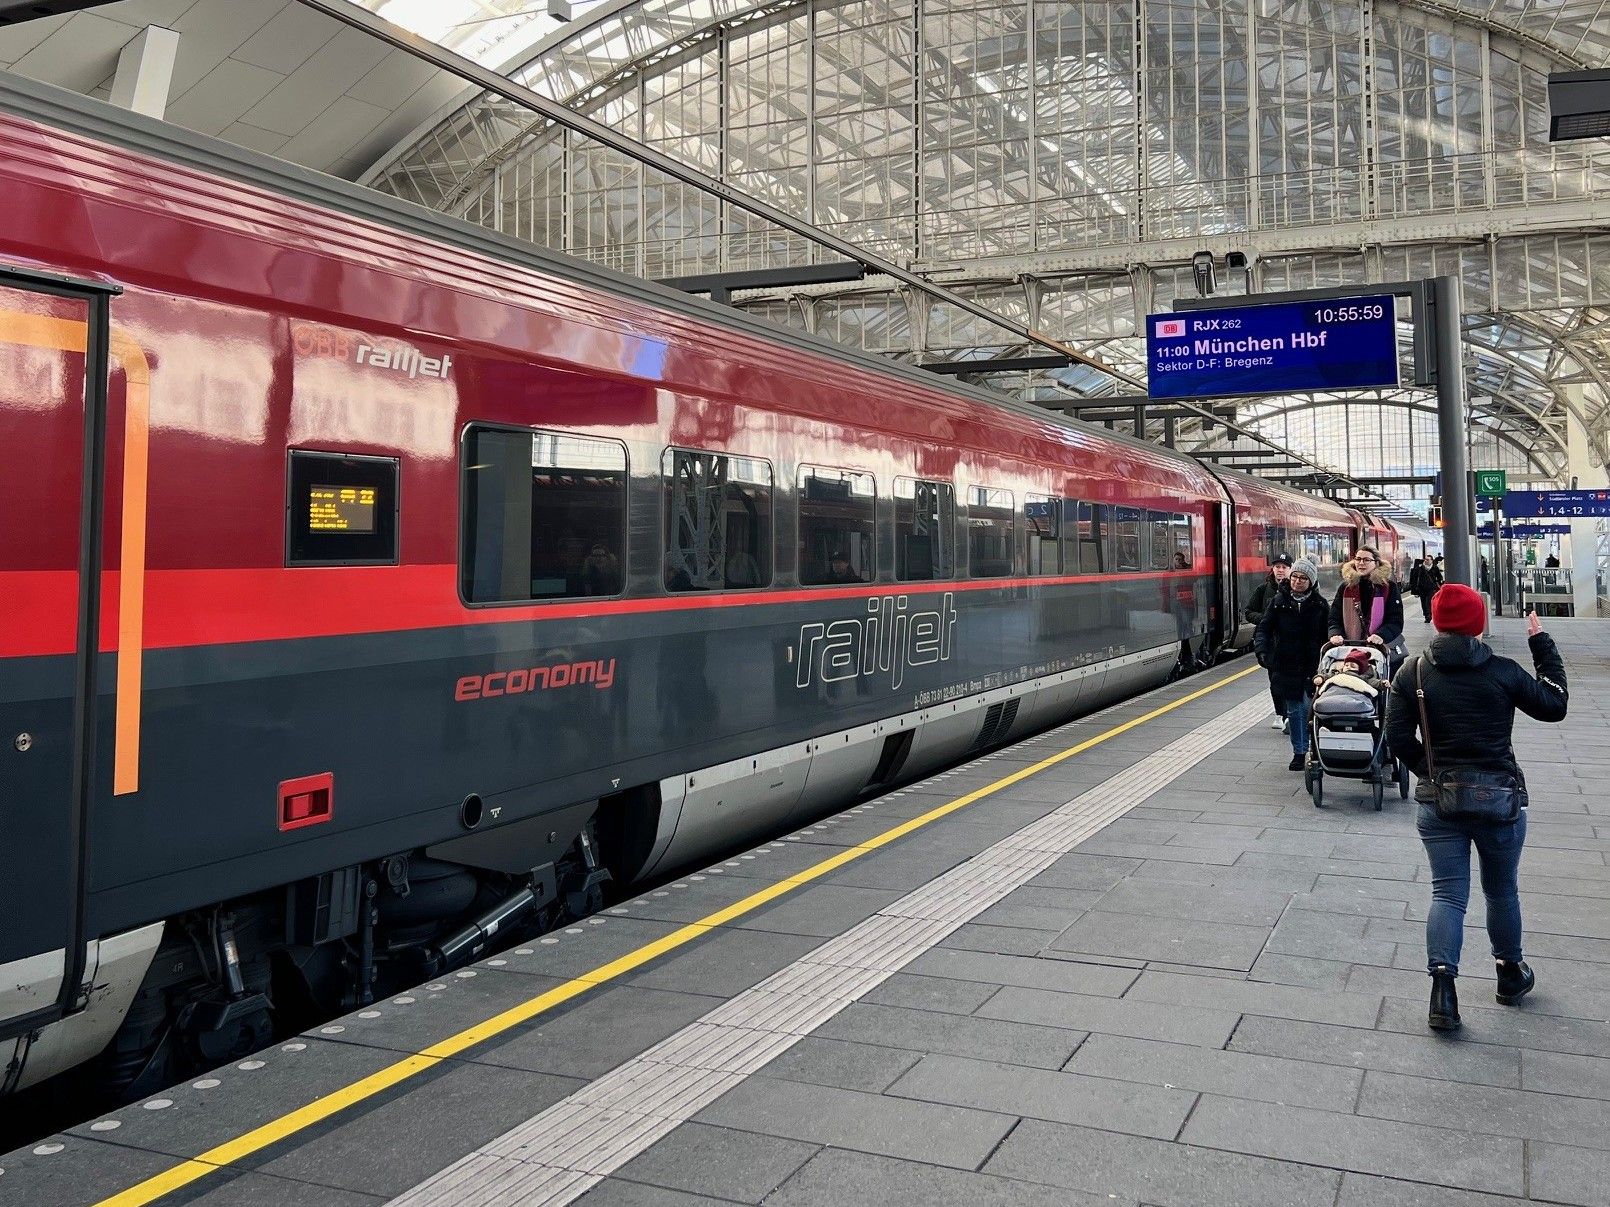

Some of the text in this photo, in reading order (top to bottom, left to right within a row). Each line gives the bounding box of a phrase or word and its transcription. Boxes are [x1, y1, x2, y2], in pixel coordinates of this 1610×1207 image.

[1314, 305, 1383, 323] 10:55:59
[1164, 324, 1177, 334] DB
[1193, 319, 1241, 332] RJX 262
[1156, 331, 1327, 358] 11:00 München Hbf
[356, 344, 453, 379] railjet
[1156, 356, 1273, 372] Sektor D-F: Bregenz
[796, 592, 957, 690] railjet
[454, 656, 616, 702] economy
